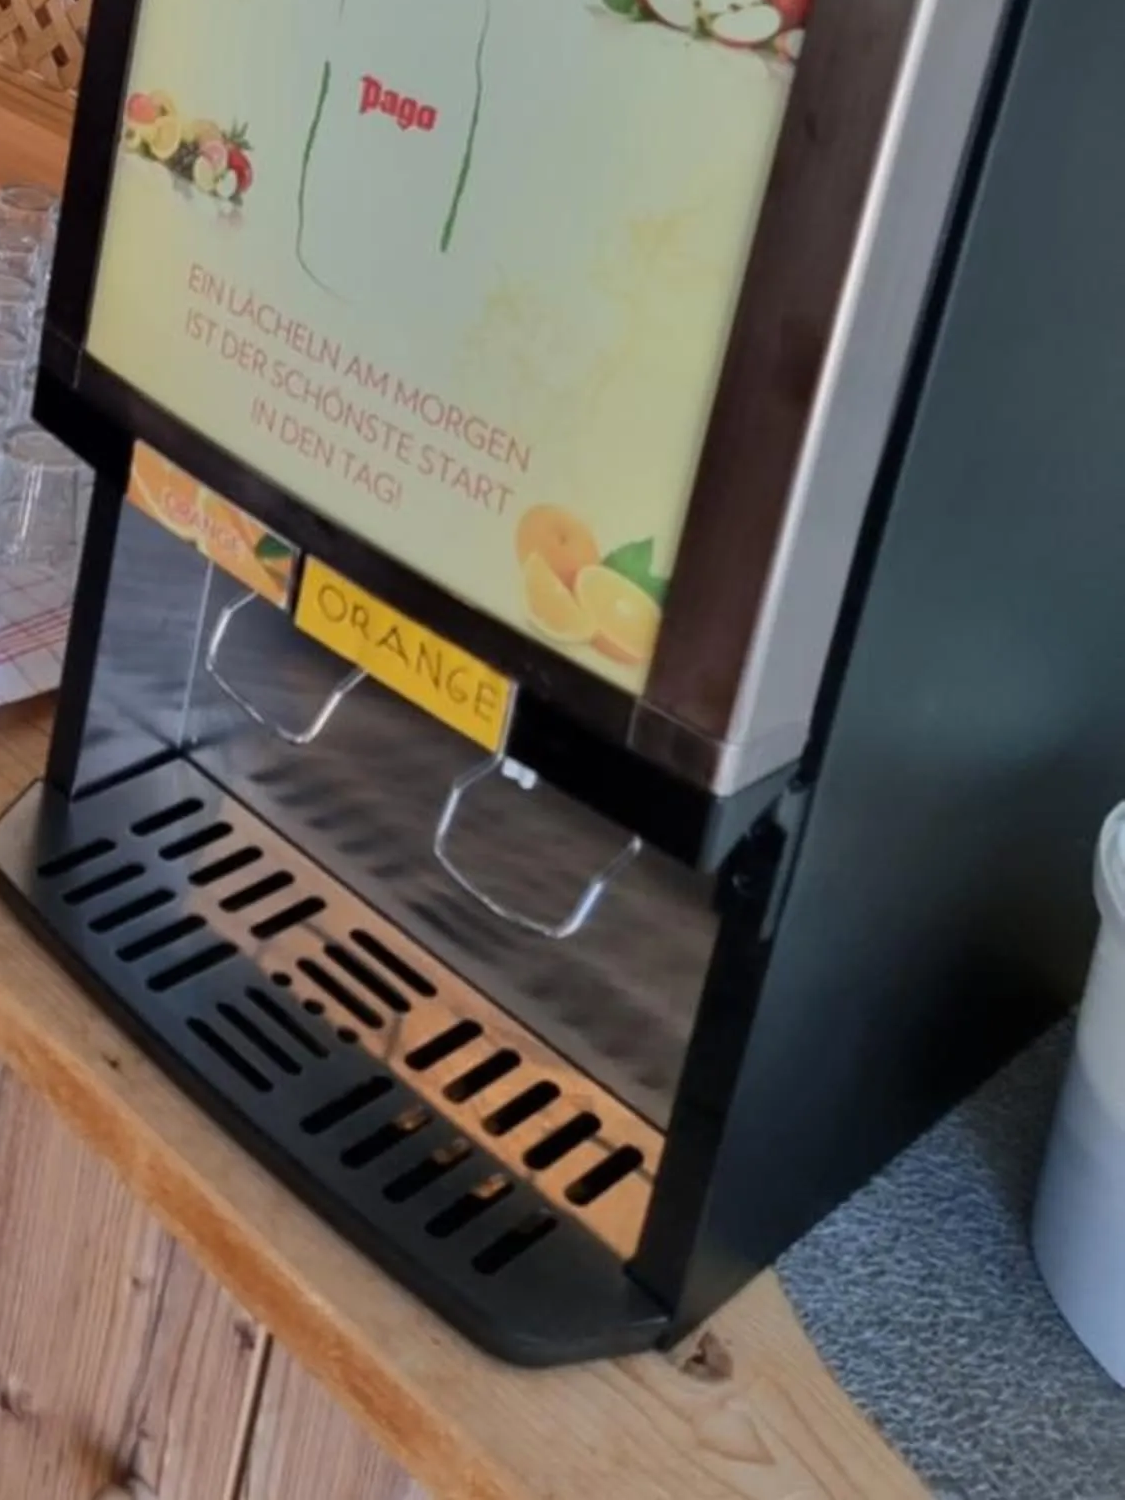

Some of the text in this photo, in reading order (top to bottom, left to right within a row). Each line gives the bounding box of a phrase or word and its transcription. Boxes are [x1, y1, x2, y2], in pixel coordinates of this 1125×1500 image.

[185, 307, 516, 516] IST DER SCHÖNSTE START
[187, 263, 531, 473] EIN LÄCHELN AM MORGEN
[250, 397, 404, 511] IN DEN TAG!
[316, 583, 499, 726] ORANGE
